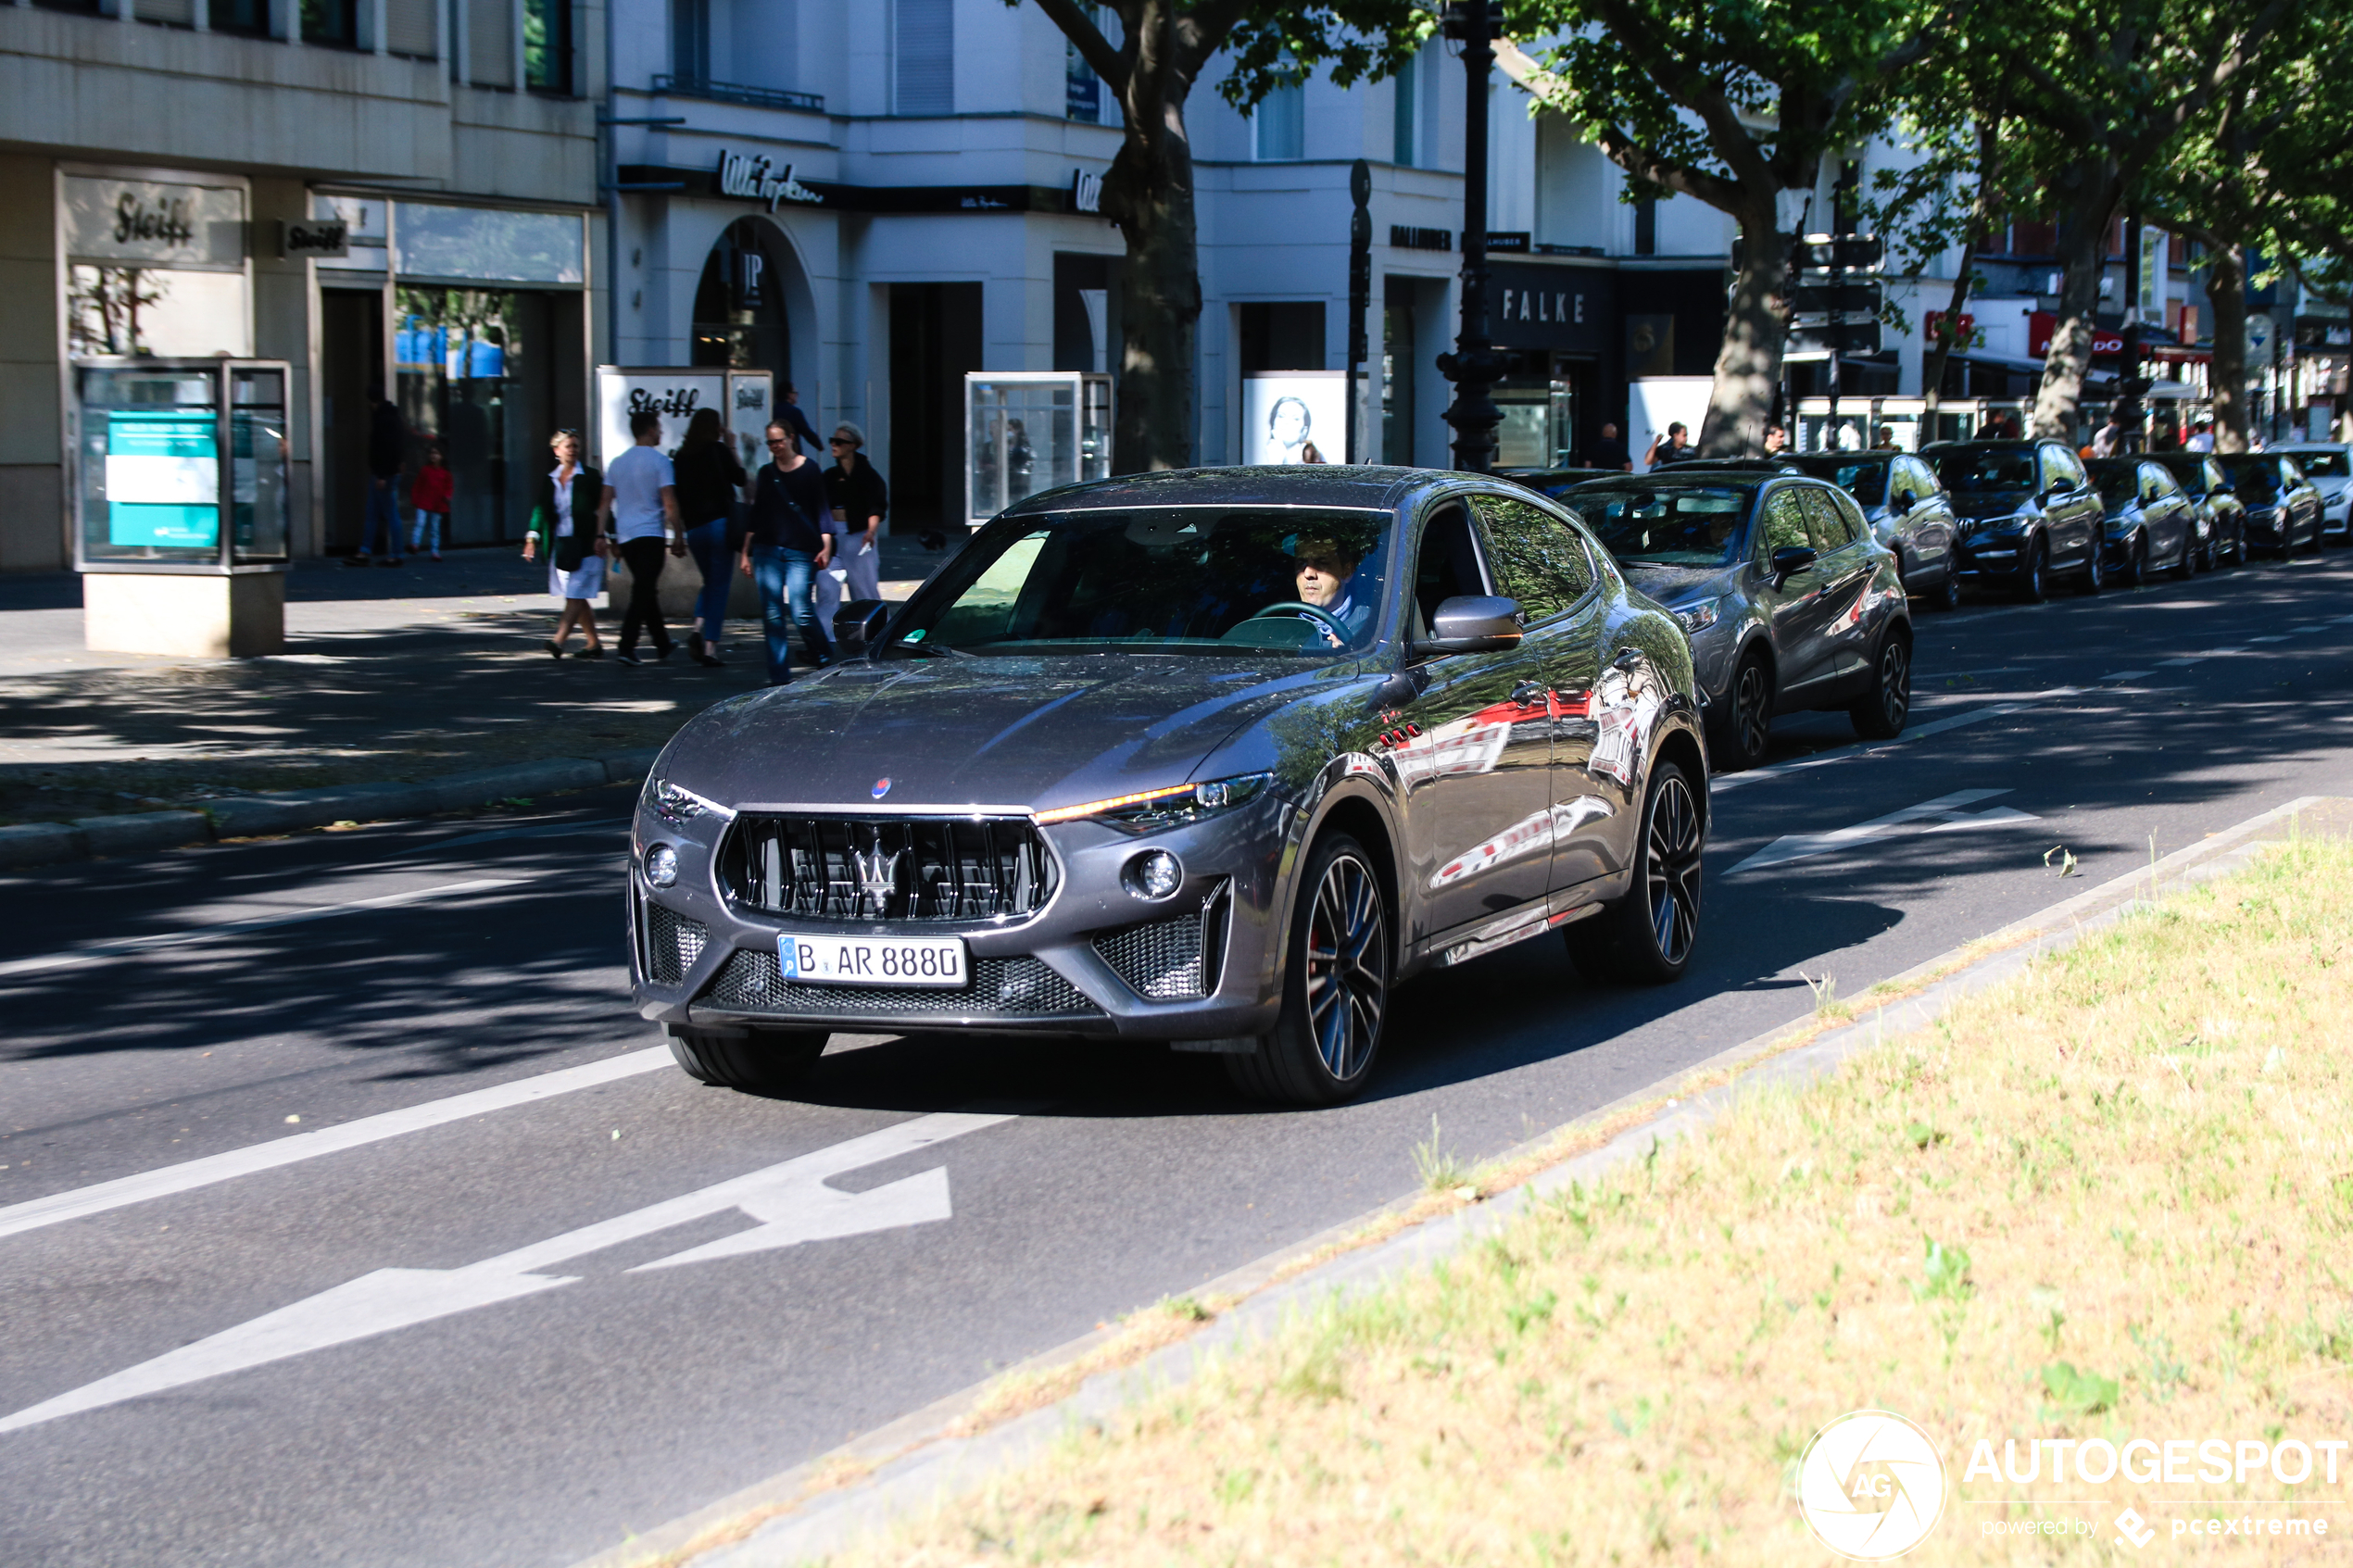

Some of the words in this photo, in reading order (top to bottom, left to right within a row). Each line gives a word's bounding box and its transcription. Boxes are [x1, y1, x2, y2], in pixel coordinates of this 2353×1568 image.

[721, 149, 758, 197] Ulla
[758, 155, 824, 214] Popken
[1076, 169, 1103, 212] Ull
[114, 191, 193, 247] Steiff
[287, 226, 345, 250] Steiff
[1488, 237, 1521, 246] LHUBER
[1503, 289, 1584, 323] FALKE
[627, 387, 699, 418] Steiff
[799, 944, 815, 972] B
[838, 946, 874, 975] AR
[882, 947, 958, 976] 8880
